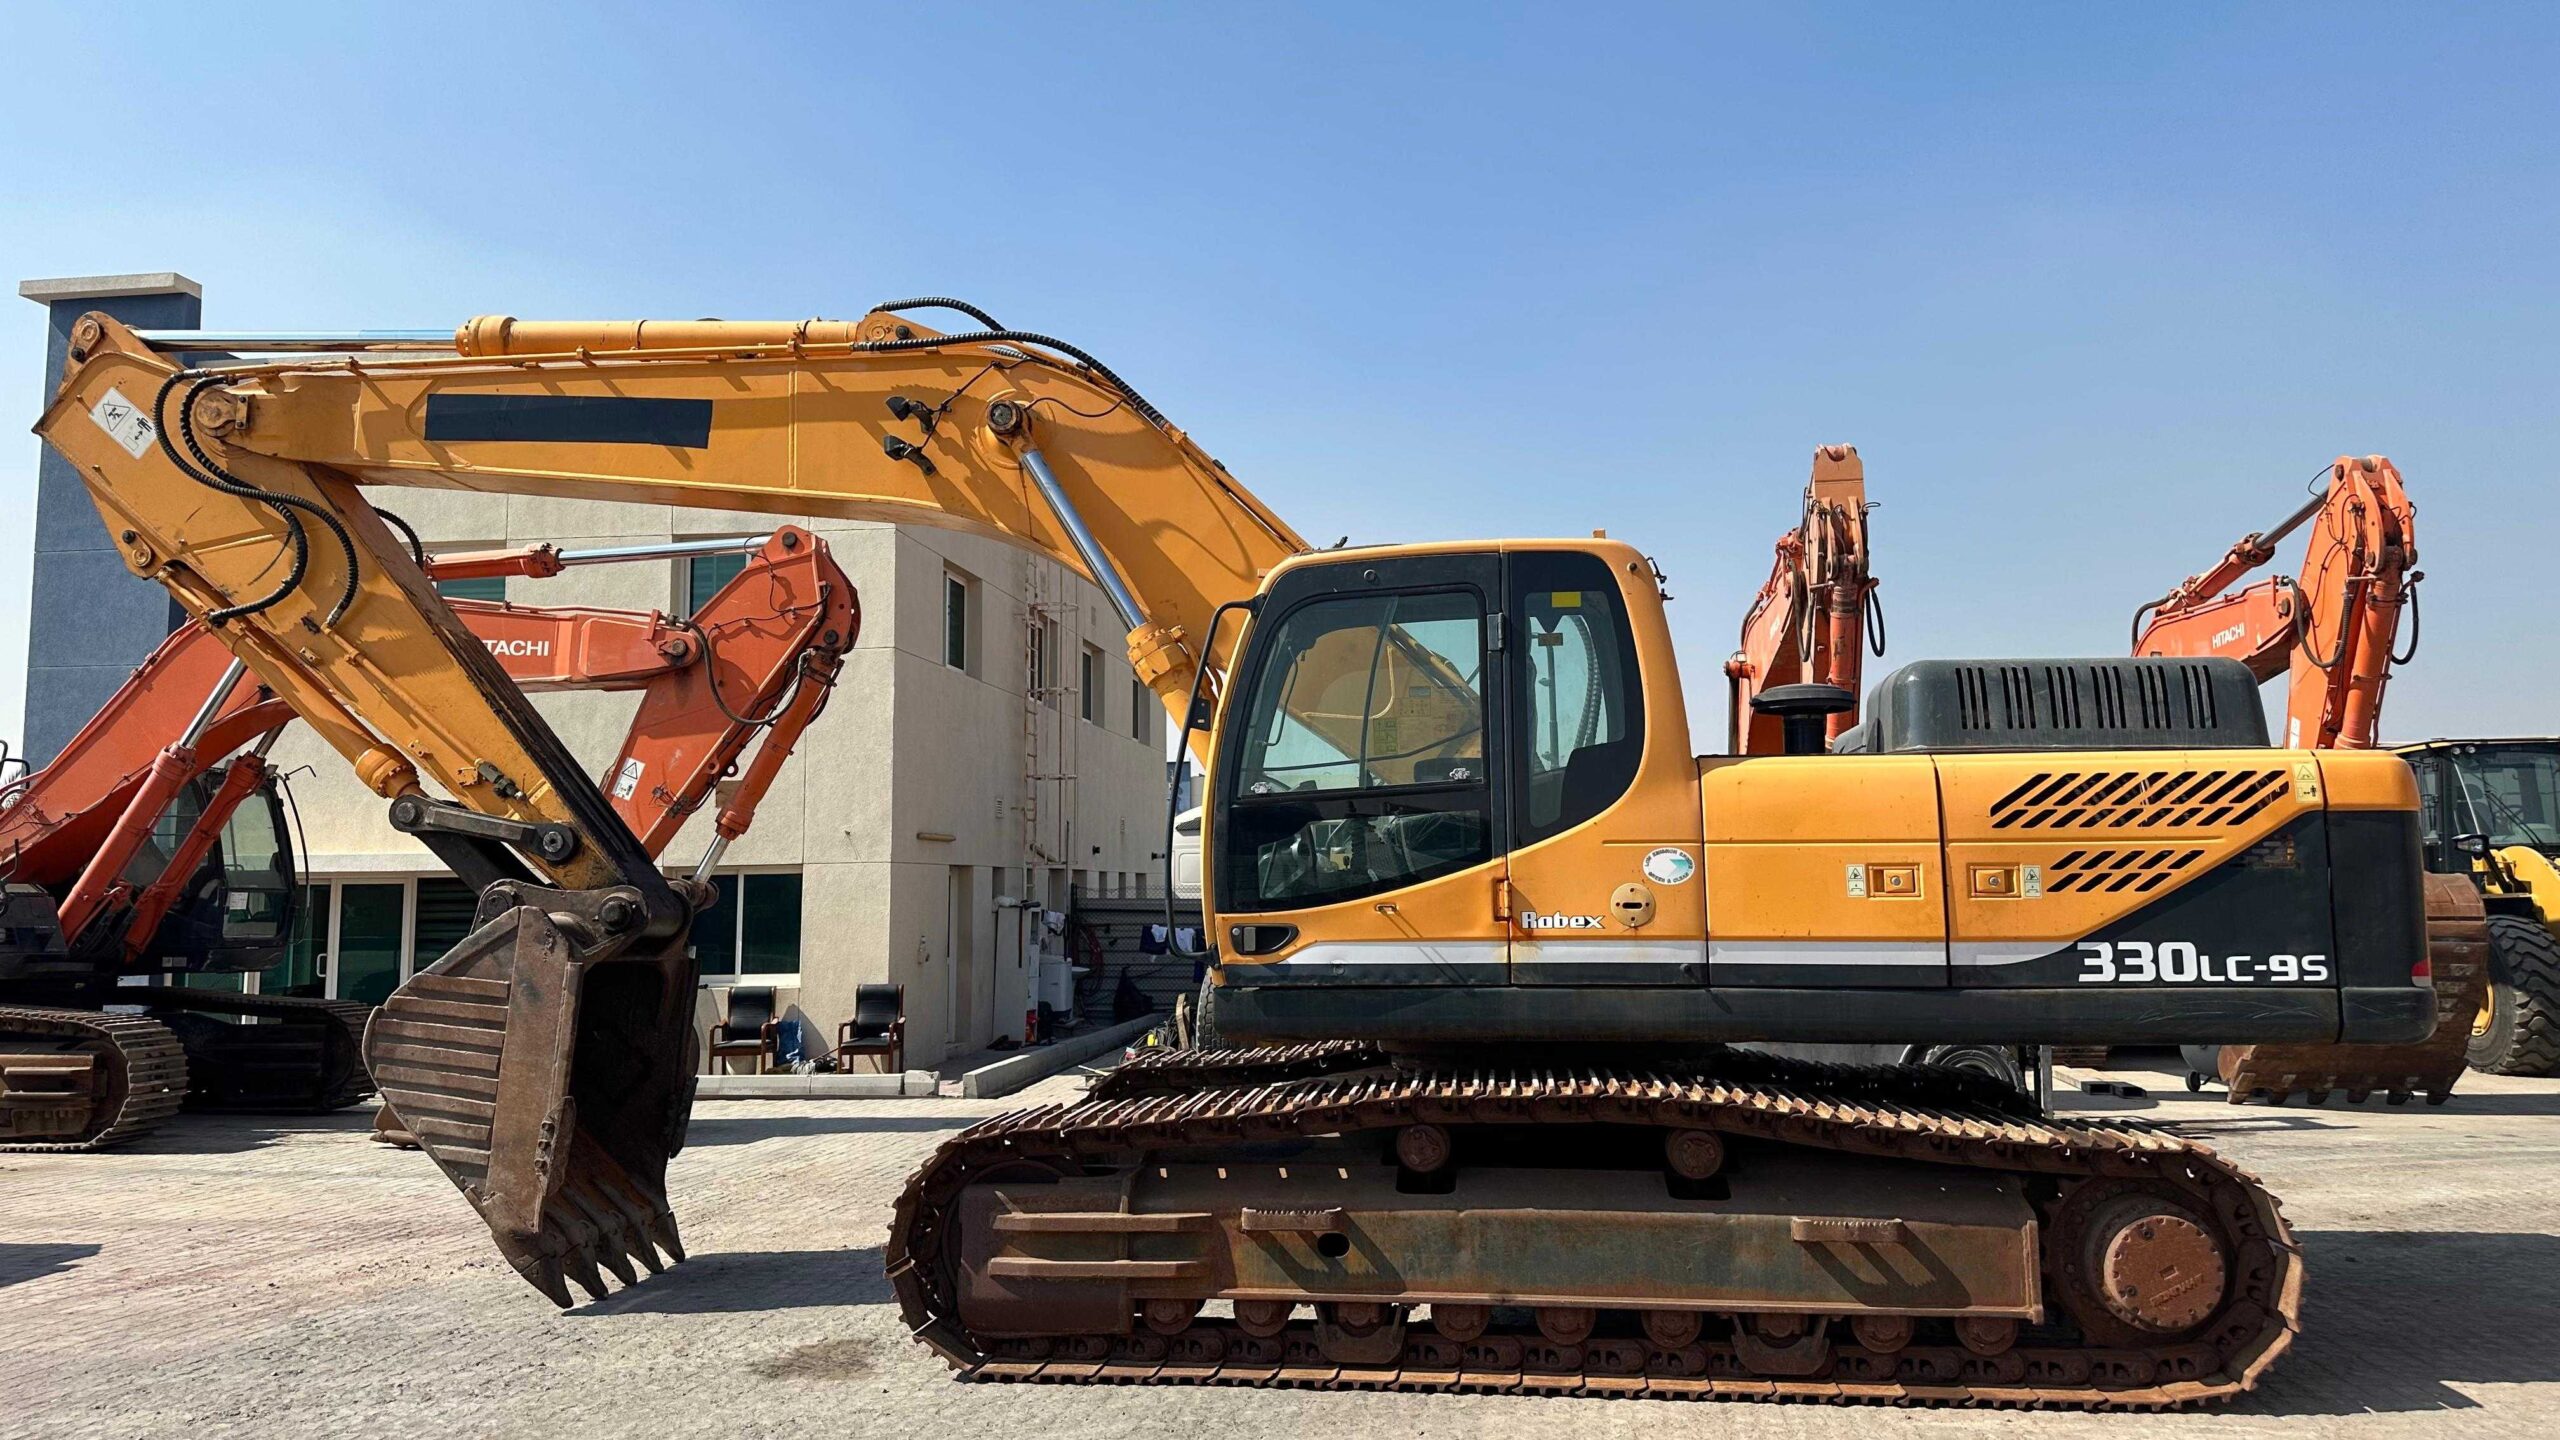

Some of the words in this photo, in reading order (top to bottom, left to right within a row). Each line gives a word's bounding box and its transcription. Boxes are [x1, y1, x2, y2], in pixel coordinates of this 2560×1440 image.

[2211, 622, 2245, 649] HITACHI
[482, 639, 550, 657] TACHI
[1521, 911, 1605, 930] Robex
